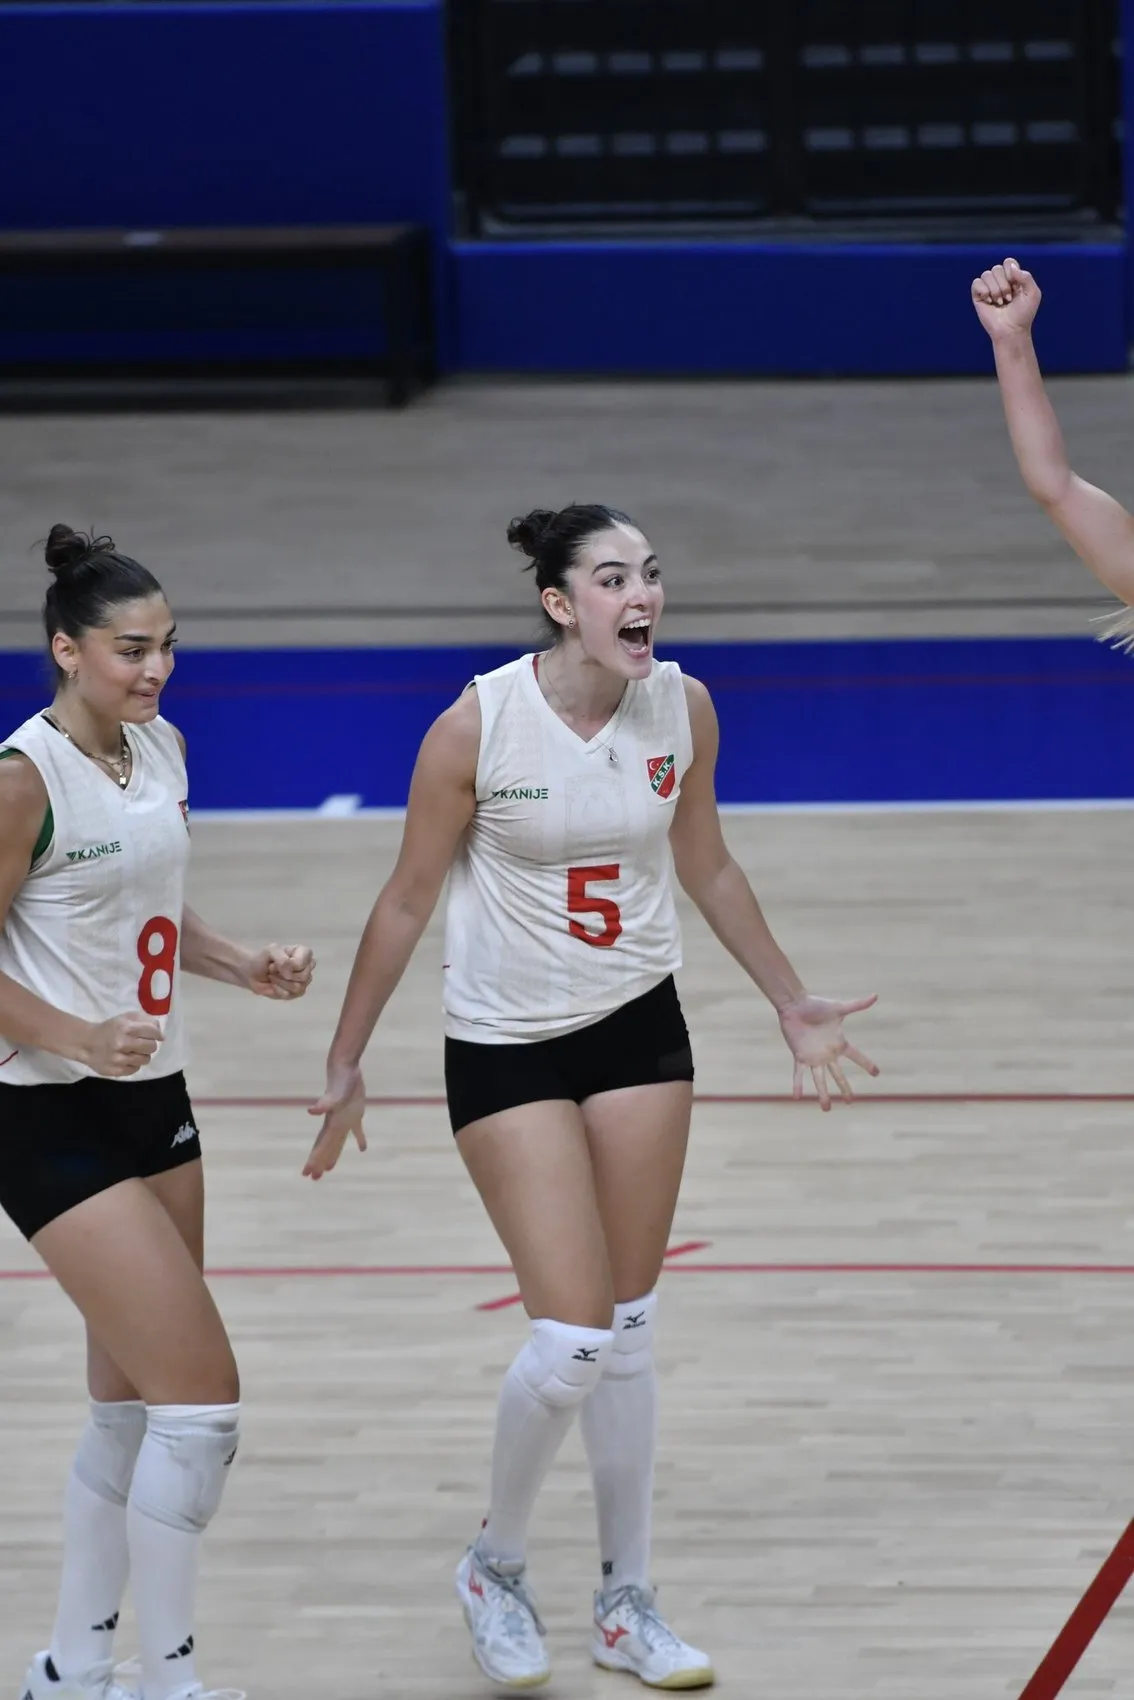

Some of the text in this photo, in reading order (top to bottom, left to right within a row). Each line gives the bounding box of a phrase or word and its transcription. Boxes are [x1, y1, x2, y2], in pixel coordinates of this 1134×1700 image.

[501, 788, 549, 800] KANIJE
[78, 841, 122, 859] KANIJE
[567, 864, 623, 947] 5
[137, 916, 178, 1016] 8
